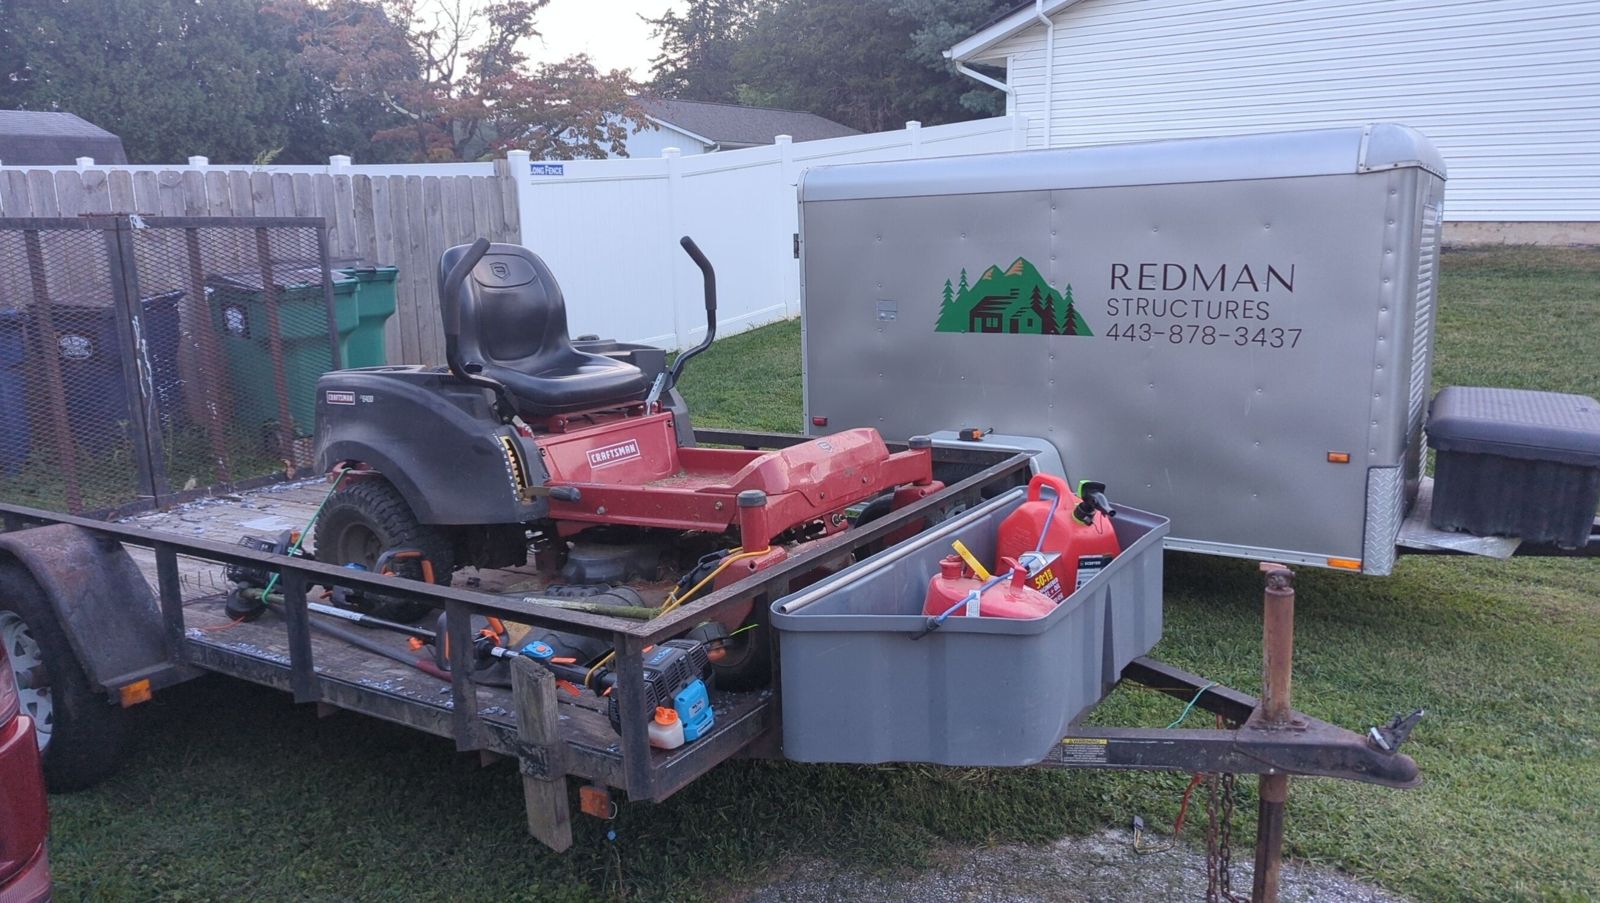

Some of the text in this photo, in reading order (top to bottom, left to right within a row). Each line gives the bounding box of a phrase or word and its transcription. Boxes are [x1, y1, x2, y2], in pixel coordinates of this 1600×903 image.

[1110, 263, 1295, 293] REDMAN
[1106, 298, 1270, 321] STRUCTURES
[1106, 322, 1303, 349] 443-878-3437
[591, 444, 636, 462] CRAFTSMAN
